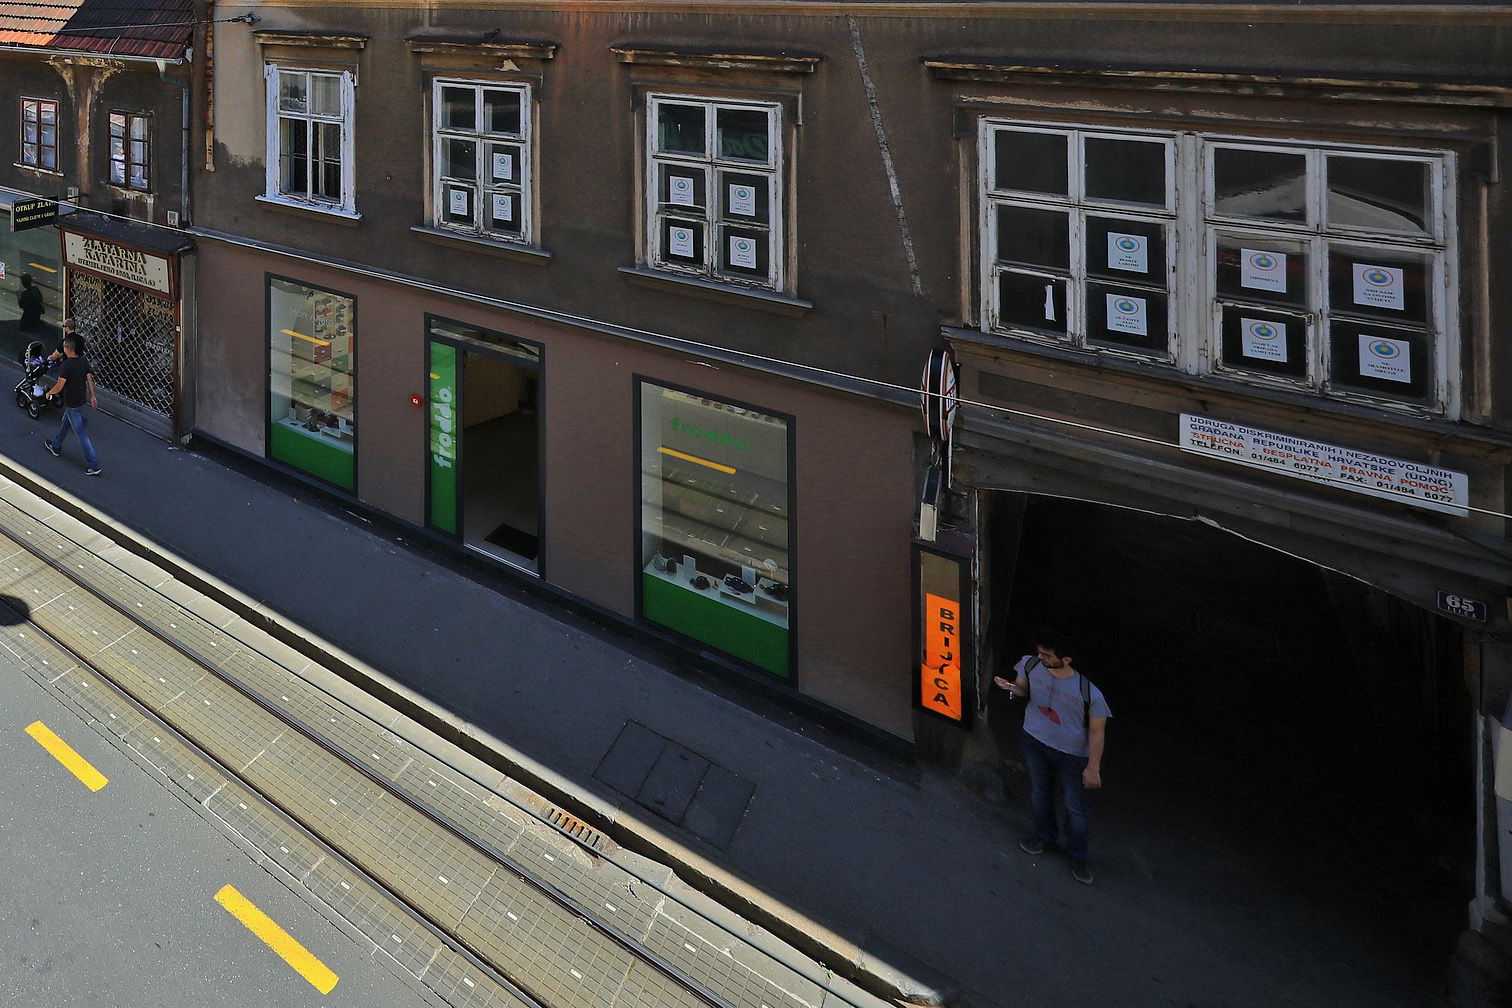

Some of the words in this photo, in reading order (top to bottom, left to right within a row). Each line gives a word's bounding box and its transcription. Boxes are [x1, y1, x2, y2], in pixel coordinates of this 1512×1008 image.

[15, 203, 36, 212] OTKUP
[82, 237, 147, 264] ZLATARNA
[84, 248, 147, 276] KATARINA
[433, 387, 453, 469] froddo
[1190, 416, 1236, 432] UDRUGA
[1238, 425, 1336, 454] DISKRIMINIRANIH
[1346, 451, 1453, 479] NEZADOVOLJNIH
[1253, 437, 1320, 458] REPUBLIKE
[1328, 455, 1396, 475] HRVATSKE
[1405, 472, 1453, 489] (UDNG)
[1190, 439, 1244, 457] TELEFON:
[1251, 453, 1286, 465] 01/484
[1293, 462, 1320, 473] 6077
[1340, 473, 1368, 484] FAX:
[1376, 481, 1415, 495] 01/484
[1424, 492, 1454, 503] 6077
[1263, 448, 1332, 468] BESPLATNA
[1341, 465, 1392, 482] PRAVNA
[1446, 595, 1475, 612] 65
